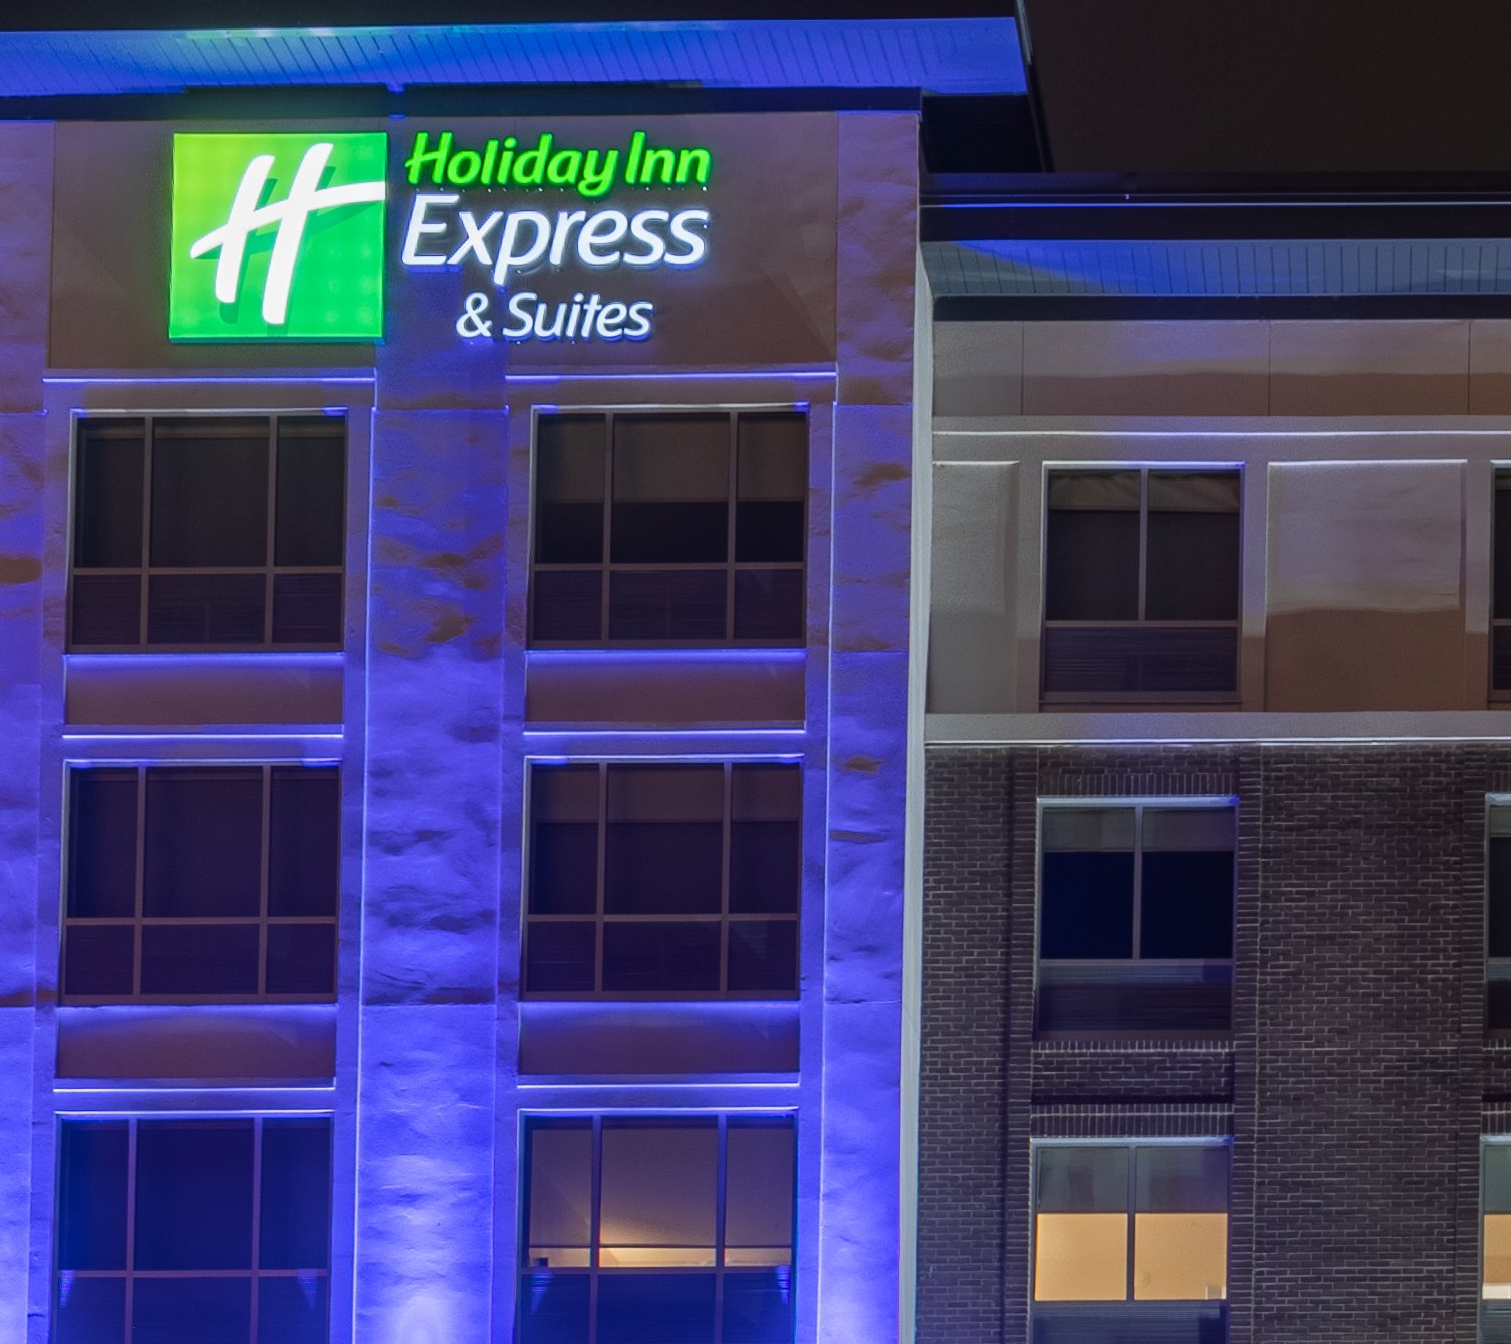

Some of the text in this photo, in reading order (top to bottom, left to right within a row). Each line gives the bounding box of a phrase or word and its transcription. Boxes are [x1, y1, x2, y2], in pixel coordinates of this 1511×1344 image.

[404, 131, 711, 195] Holiday Inn
[401, 193, 710, 286] Express
[455, 291, 653, 339] & Suites
